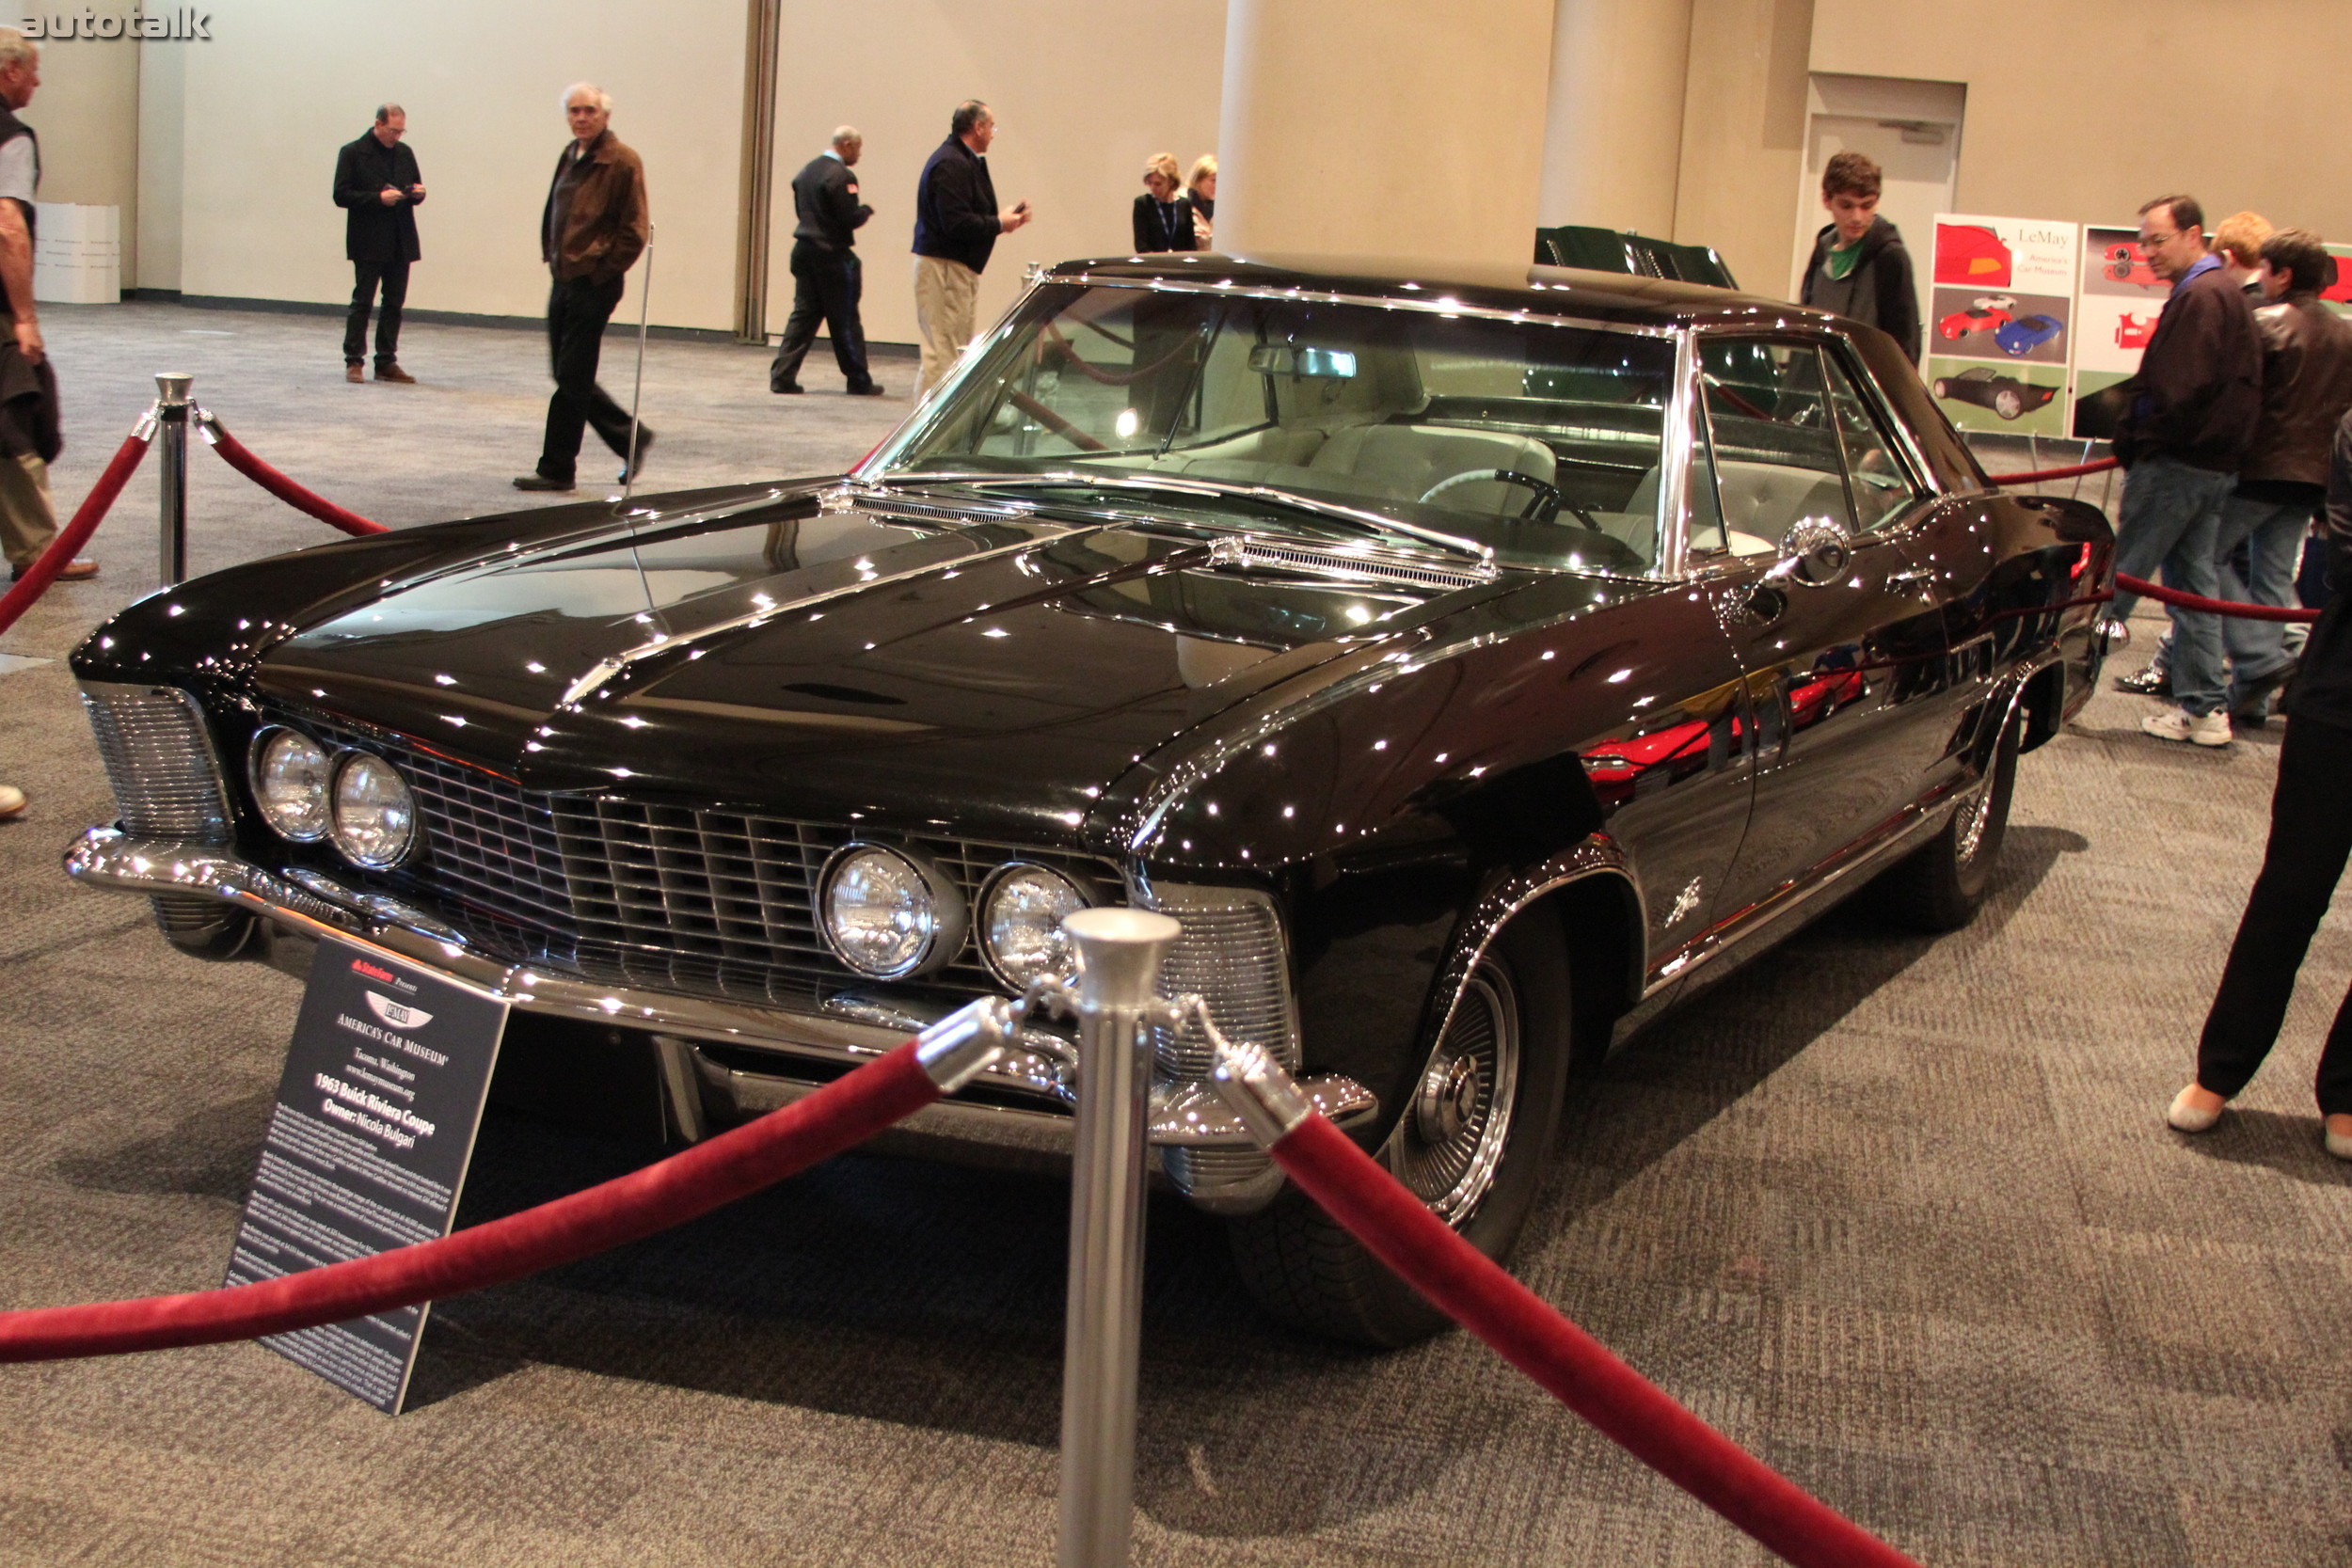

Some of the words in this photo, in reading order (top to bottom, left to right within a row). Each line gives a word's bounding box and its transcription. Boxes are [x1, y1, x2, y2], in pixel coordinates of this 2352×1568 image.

[2019, 229, 2068, 248] LeMay
[2017, 264, 2032, 274] Car
[2034, 265, 2068, 277] Museum
[395, 976, 418, 992] Presents
[337, 1013, 383, 1041] AMERICA'S
[384, 1031, 403, 1051] CAR
[379, 1057, 416, 1083] Washington
[316, 1073, 340, 1093] 1963
[340, 1083, 368, 1106] Buick
[367, 1093, 402, 1121] Riviera
[401, 1109, 436, 1136] Coupe
[324, 1099, 356, 1122] Owner:
[357, 1111, 384, 1134] Nicola
[383, 1123, 417, 1149] Bulgari
